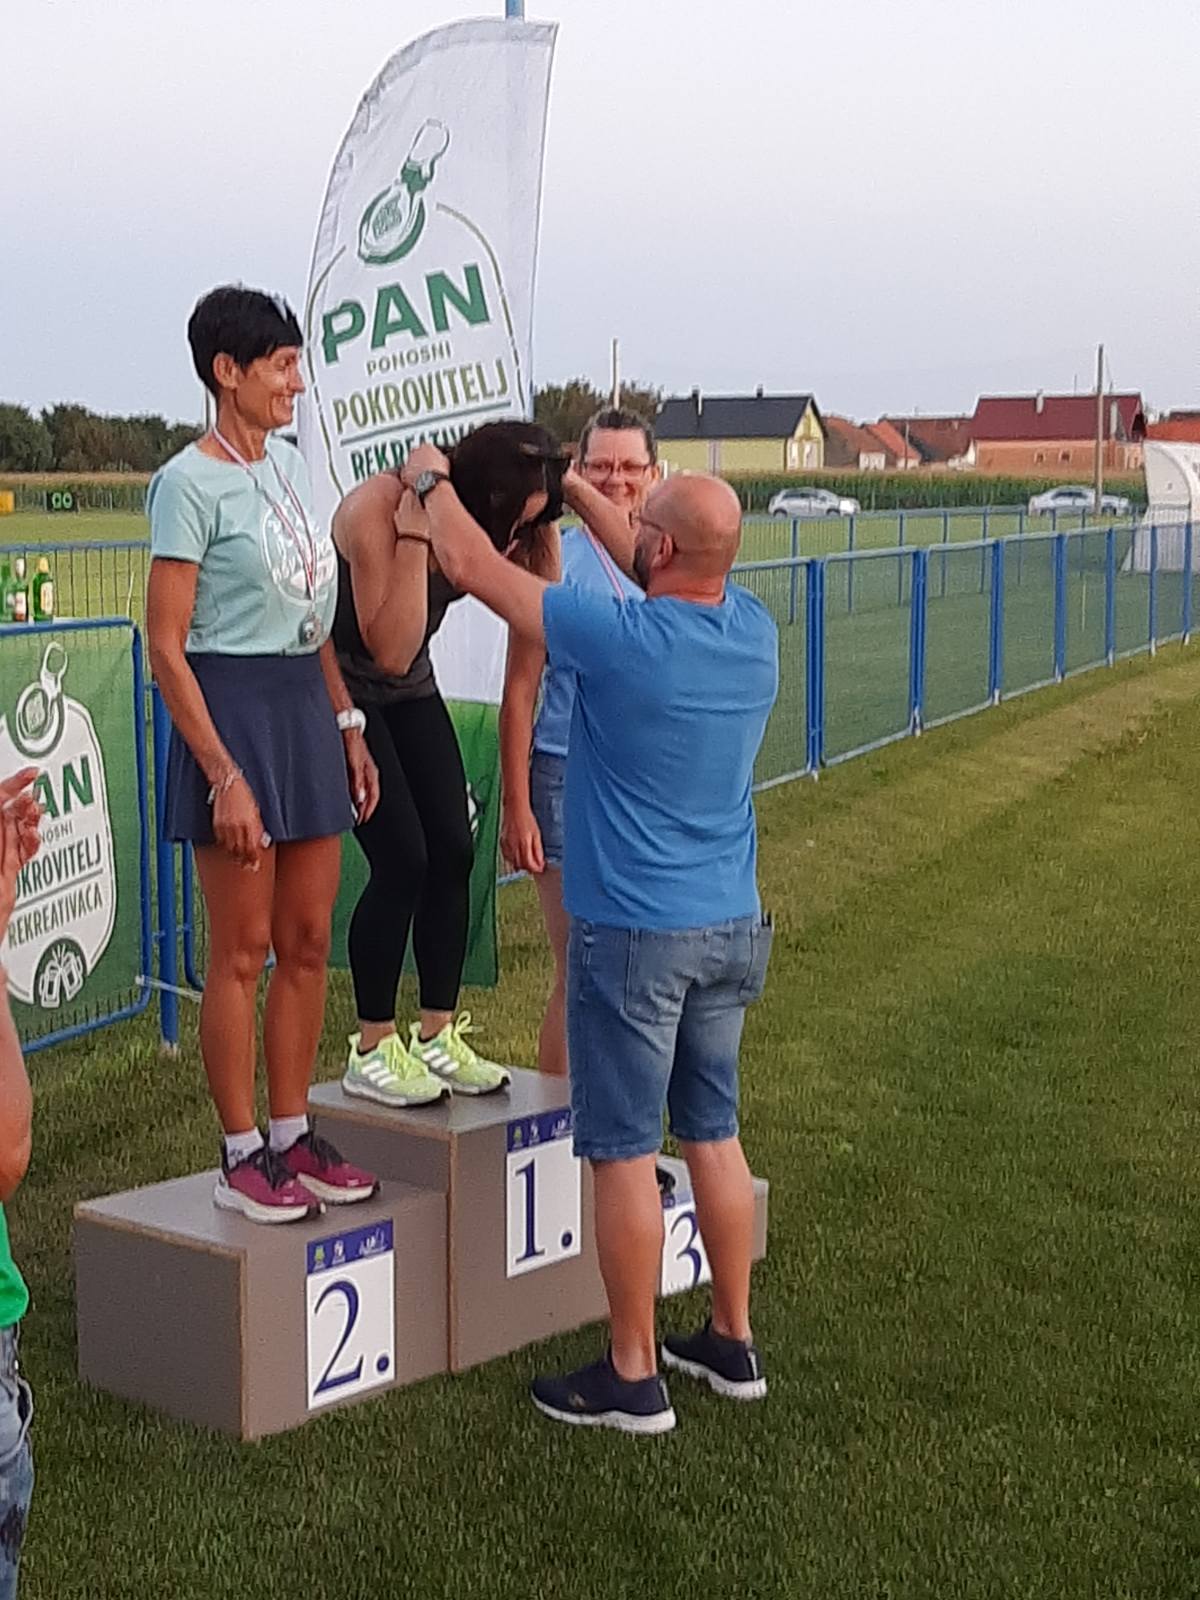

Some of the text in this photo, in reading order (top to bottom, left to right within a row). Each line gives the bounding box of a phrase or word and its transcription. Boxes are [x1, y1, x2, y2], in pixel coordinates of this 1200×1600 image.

[321, 263, 490, 364] PAN
[366, 341, 452, 376] PONOSNI
[333, 358, 508, 435] POKROVITELJ
[34, 754, 95, 822] AN
[41, 820, 74, 844] NOSNI
[16, 833, 101, 900] KROVITELJ
[8, 882, 103, 949] REKREATIVACA
[514, 1158, 573, 1263] 1.
[313, 1280, 391, 1396] 2.
